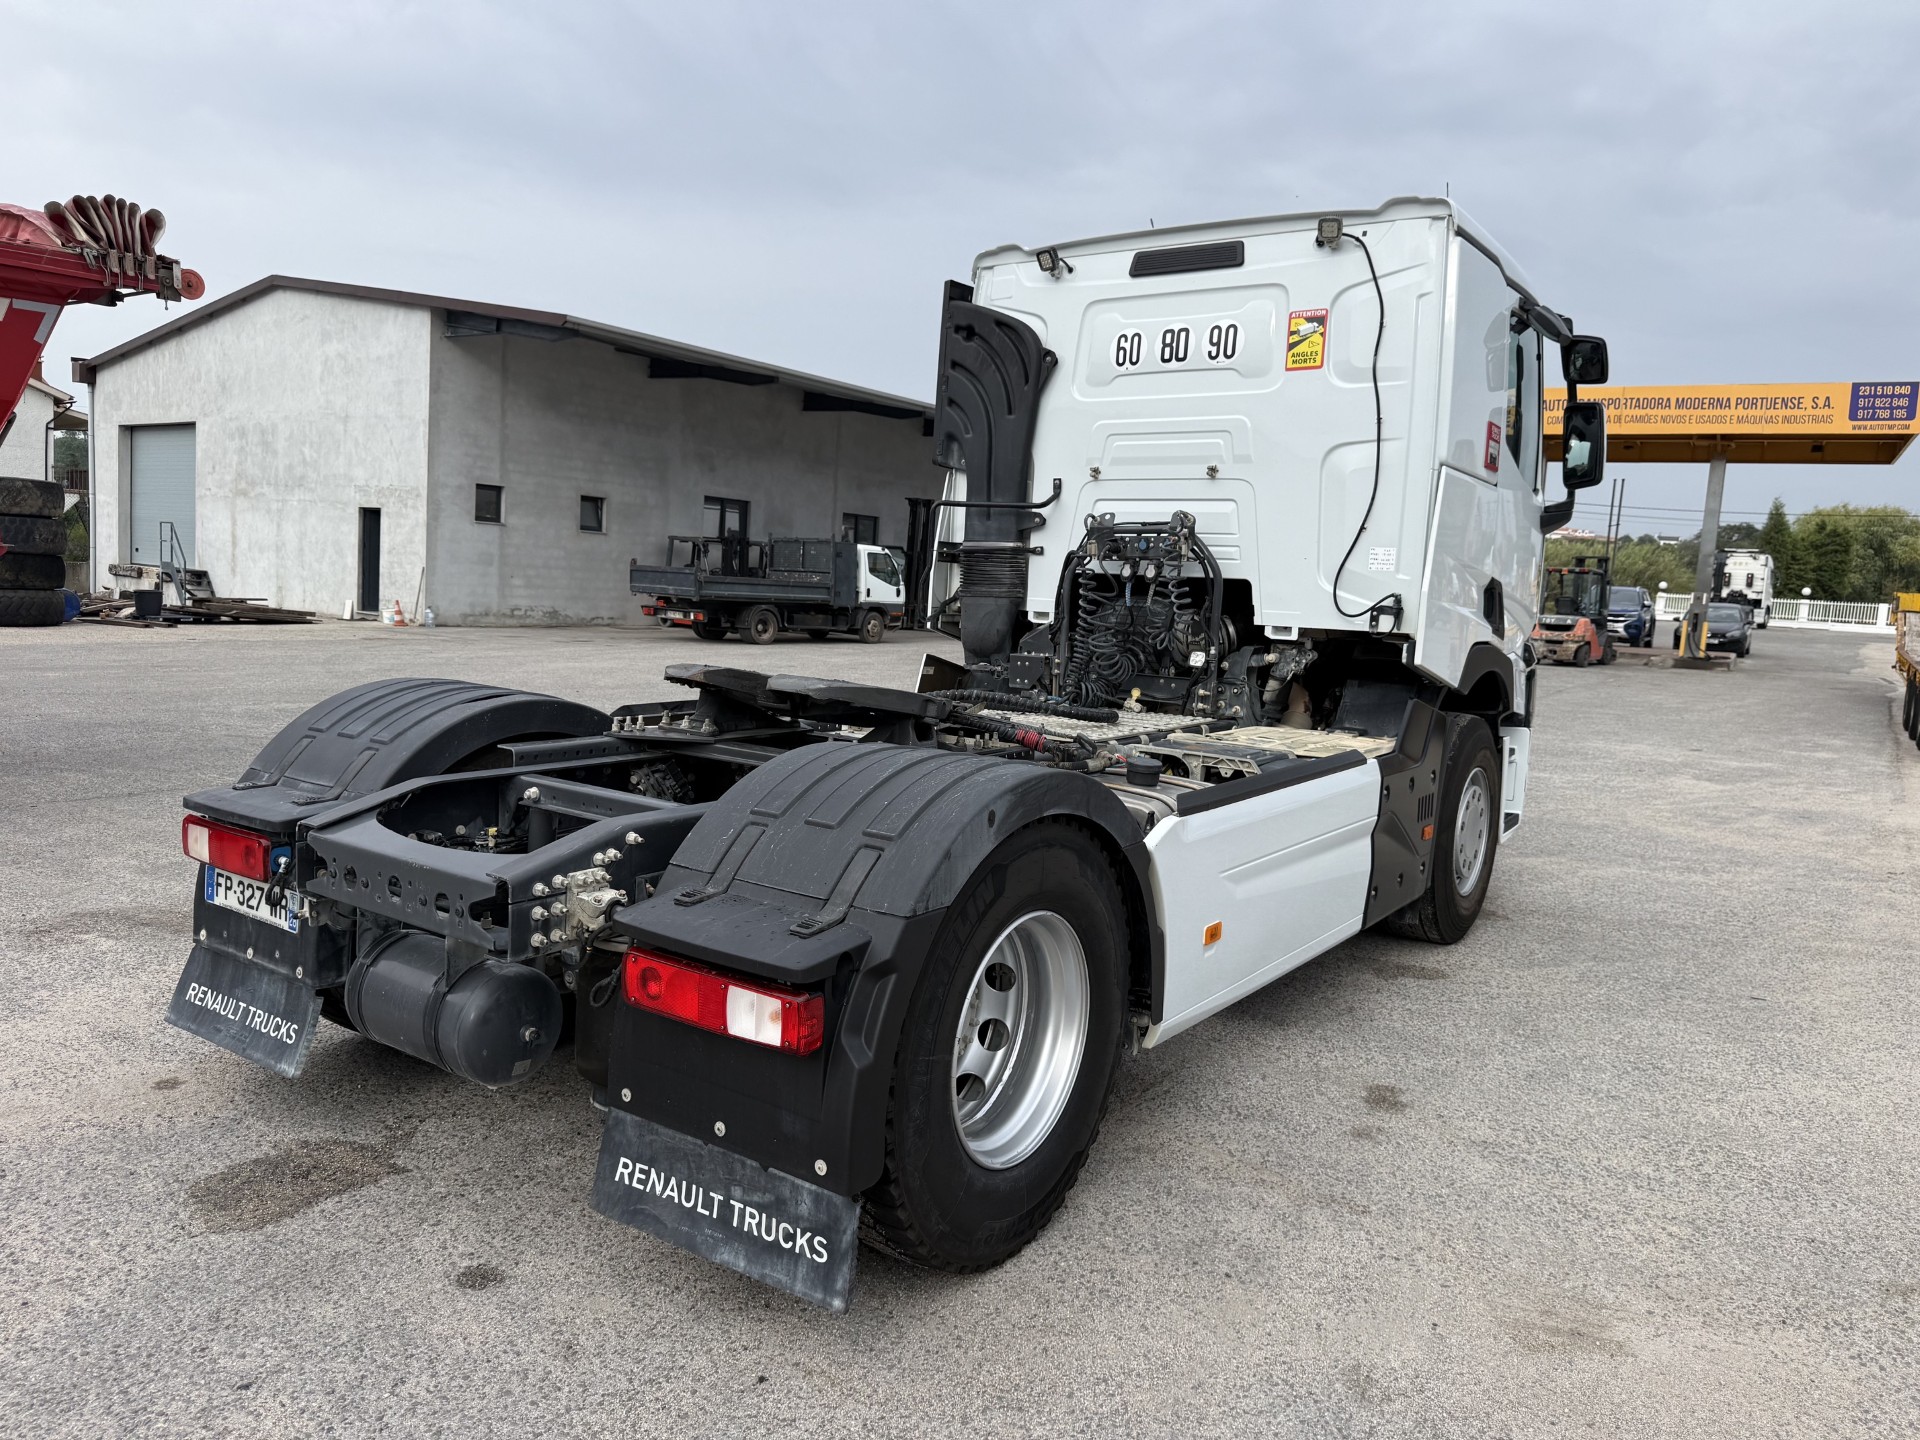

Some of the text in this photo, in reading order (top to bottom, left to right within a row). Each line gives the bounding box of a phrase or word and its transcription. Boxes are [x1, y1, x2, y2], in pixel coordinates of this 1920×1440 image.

[1291, 309, 1327, 318] ATTENTION
[1115, 323, 1238, 367] 60 80 90
[1290, 351, 1319, 359] ANGLES
[1291, 357, 1317, 365] MORTS
[1858, 385, 1911, 395] 231 510 840
[1674, 397, 1732, 410] MODERNA
[1734, 396, 1808, 411] PORTUENSE,
[1811, 396, 1835, 410] S.A.
[1858, 397, 1909, 407] 917 822 846
[1612, 414, 1622, 424] DE
[1623, 413, 1659, 424] CAMIÕES
[1660, 414, 1687, 424] NOVOS
[1695, 414, 1727, 424] USADOS
[1736, 412, 1779, 425] MÁQUINAS
[1781, 414, 1834, 424] INDUSTRIAIS
[1857, 409, 1907, 419] 917 768 195
[185, 982, 299, 1045] RENAULT TRUCKS
[614, 1156, 828, 1263] RENAULT TRUCKS
